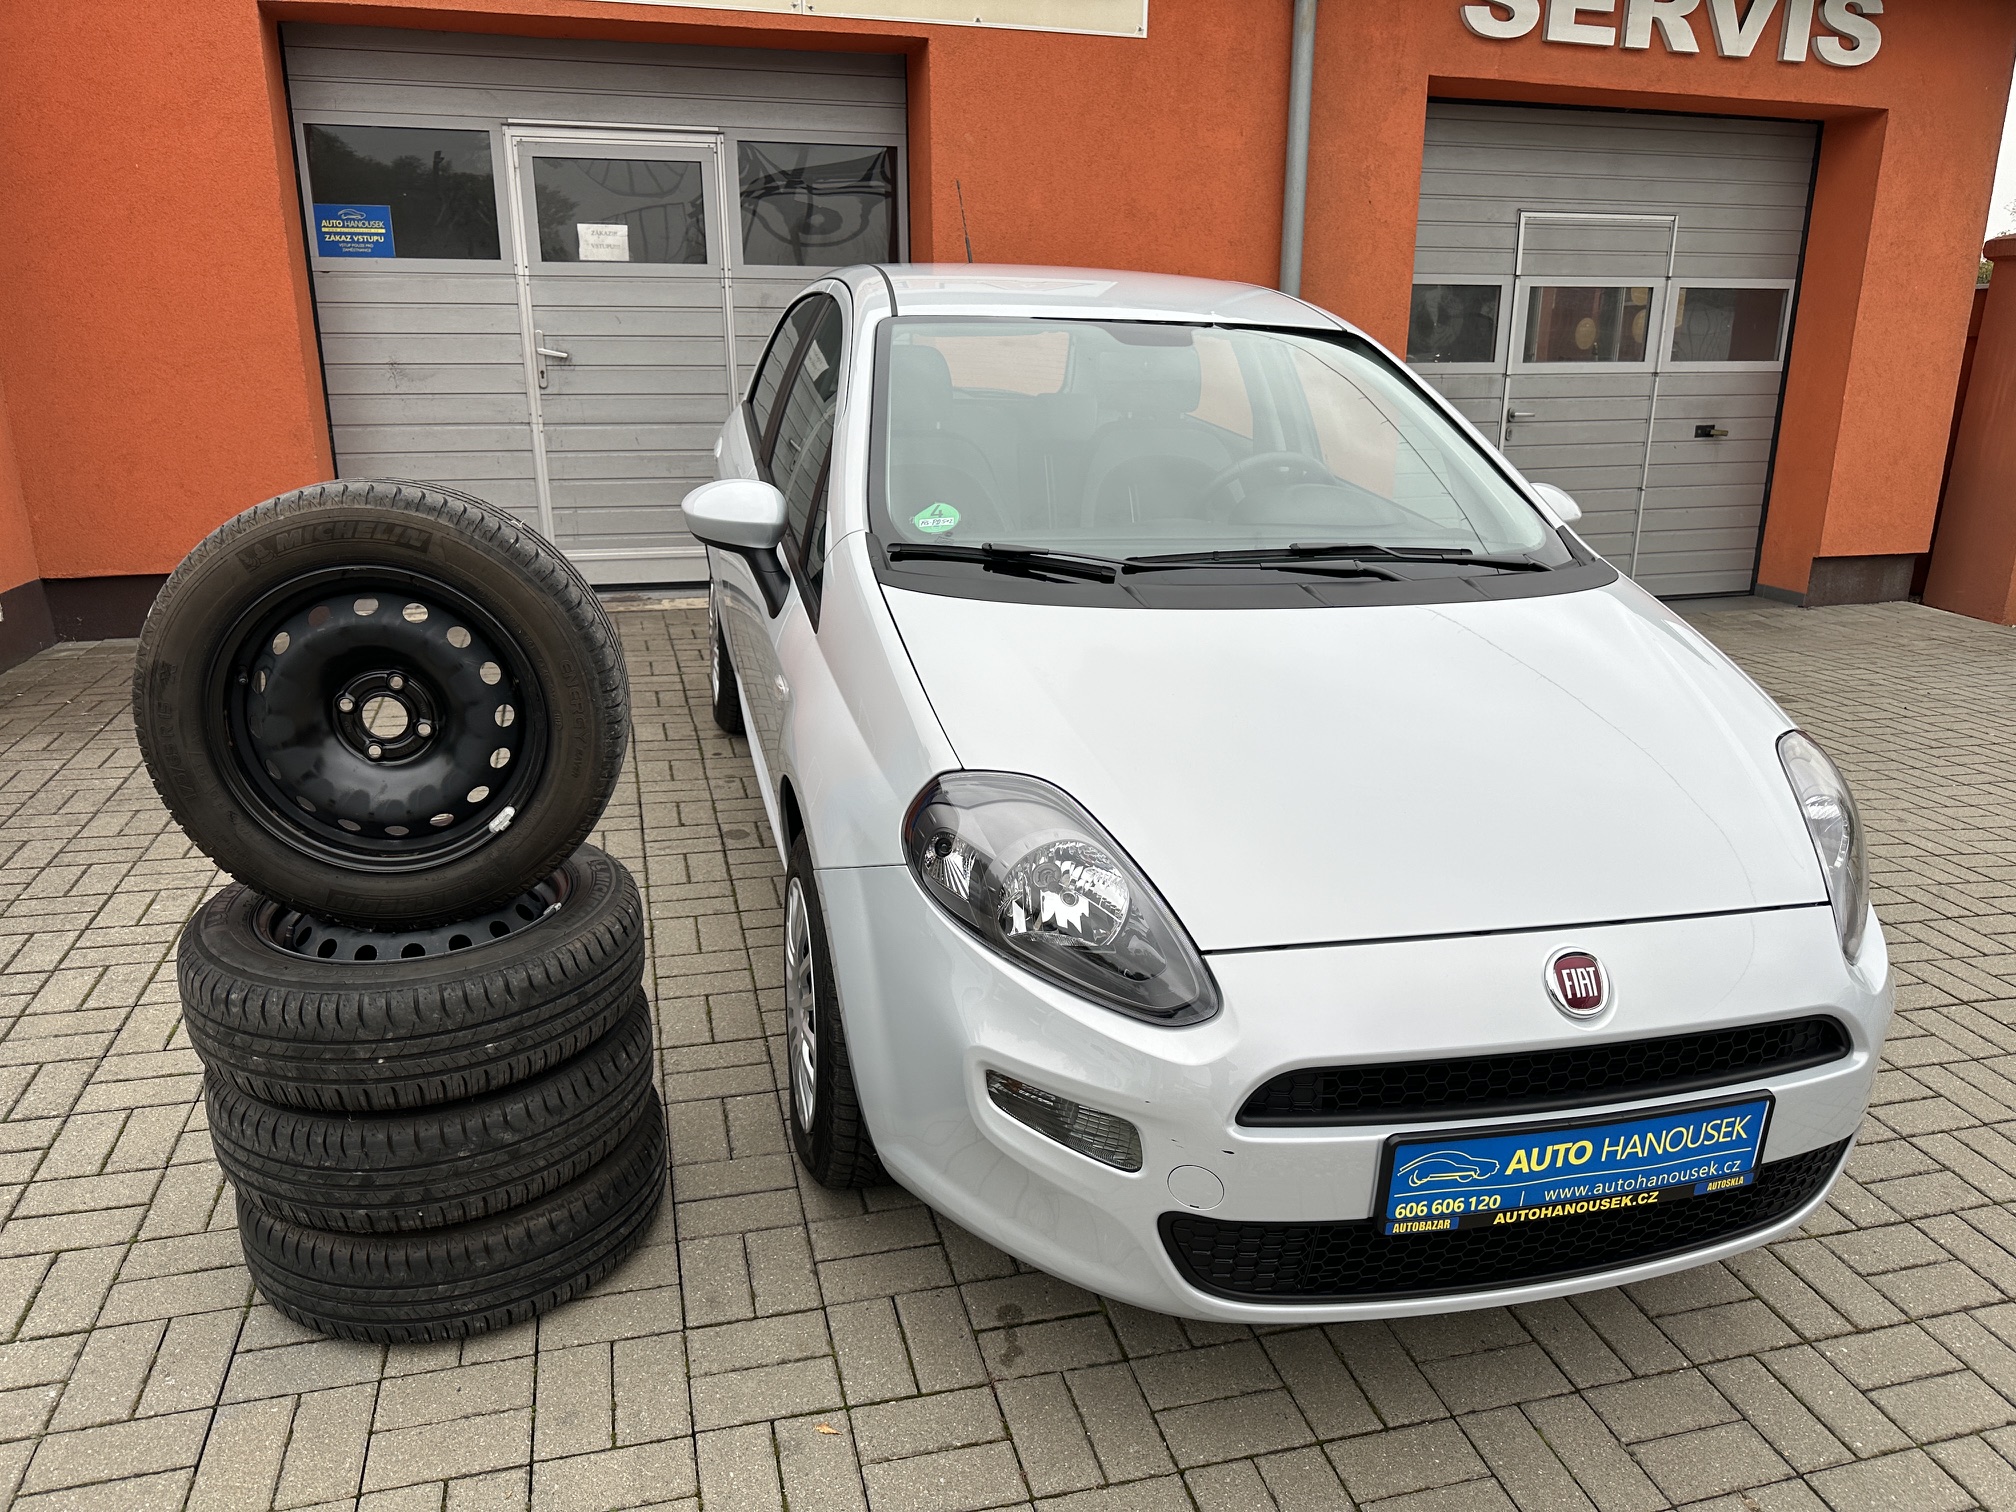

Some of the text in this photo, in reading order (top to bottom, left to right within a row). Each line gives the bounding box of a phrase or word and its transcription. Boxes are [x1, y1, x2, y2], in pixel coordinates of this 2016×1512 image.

[325, 233, 352, 241] ZÁKAZ
[344, 220, 385, 228] HANOUSEK
[931, 504, 944, 518] 4
[276, 521, 430, 557] MICHELIN
[561, 658, 589, 744] ENERGY
[1561, 966, 1599, 1000] FIAT
[1504, 1114, 1752, 1176] AUTO HANOUSEK
[1544, 1160, 1741, 1201] www.autohanousek.cz
[1706, 1175, 1745, 1192] AUTOSKLA
[1394, 1194, 1502, 1219] 606 606 120
[1493, 1191, 1660, 1226] AUTOHANOUSEK.CZ
[1392, 1219, 1451, 1234] AUTOBAZAR
